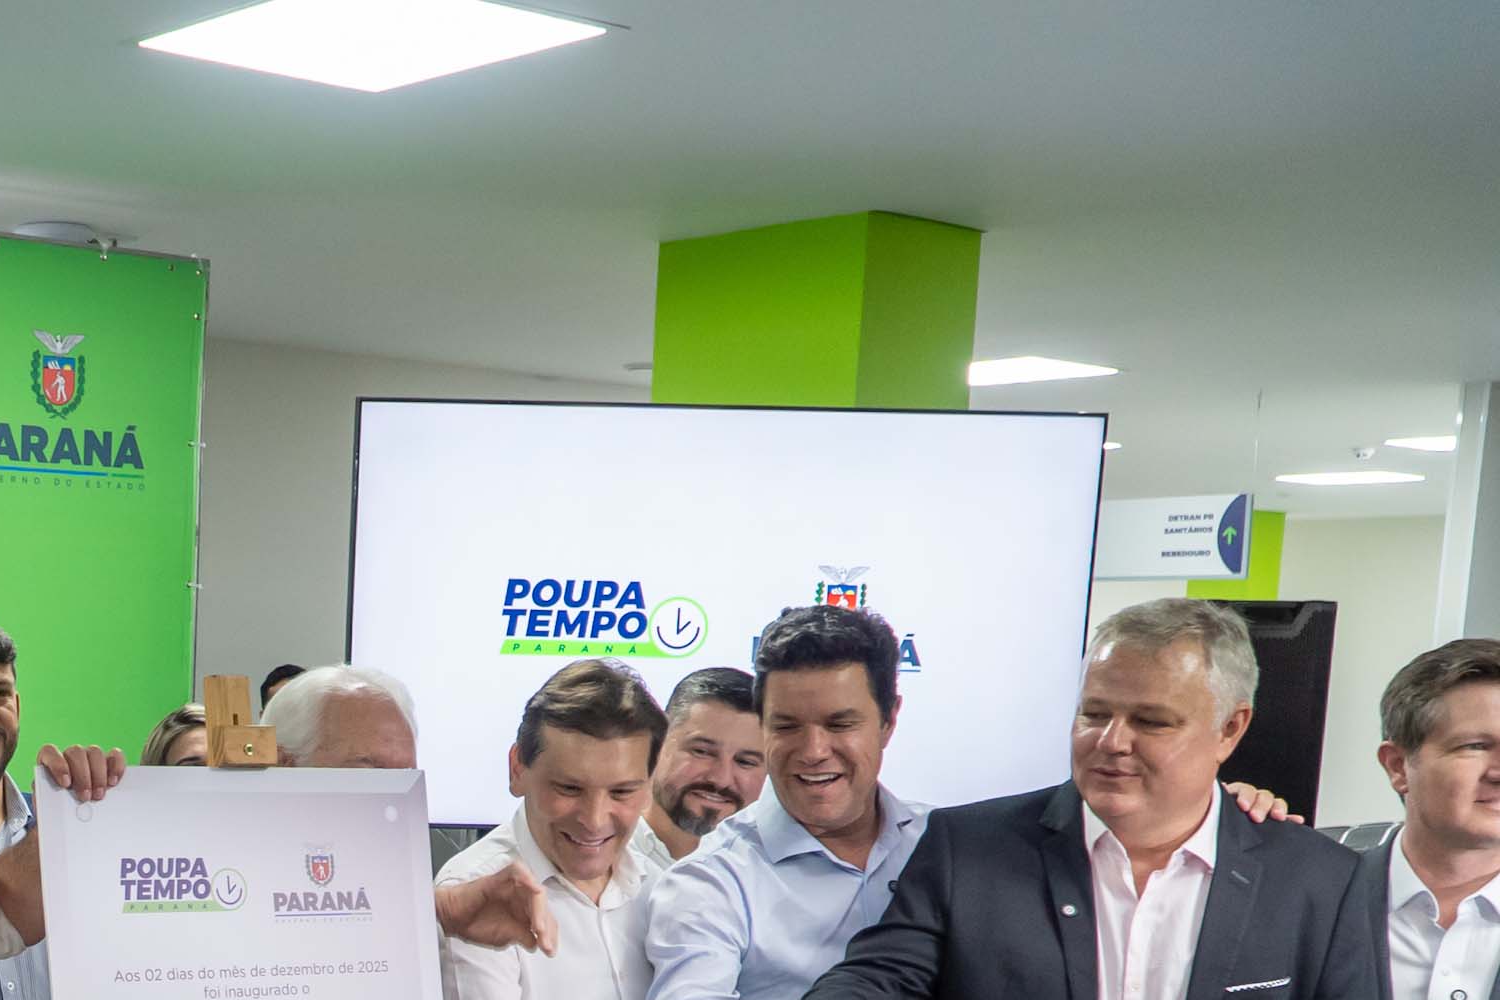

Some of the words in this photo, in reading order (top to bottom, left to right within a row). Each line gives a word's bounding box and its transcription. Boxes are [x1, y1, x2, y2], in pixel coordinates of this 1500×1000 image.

[54, 478, 73, 488] DO
[85, 481, 145, 491] ESTADO
[504, 579, 645, 609] POUPA
[502, 609, 648, 639] TEMPO
[512, 643, 637, 654] PARANÁ
[120, 857, 208, 879] POUPA
[120, 879, 211, 901] TEMPO
[273, 887, 371, 912] PARANÁ
[114, 969, 141, 983] Aos
[145, 968, 163, 982] 02
[167, 967, 194, 981] dias
[198, 965, 215, 980] do
[220, 965, 246, 978] mês
[250, 963, 267, 977] de
[270, 961, 335, 977] dezembro
[338, 961, 354, 974] de
[358, 960, 389, 973] 2025
[204, 985, 221, 999] foi
[225, 984, 298, 999] inaugurado
[302, 985, 310, 995] o
